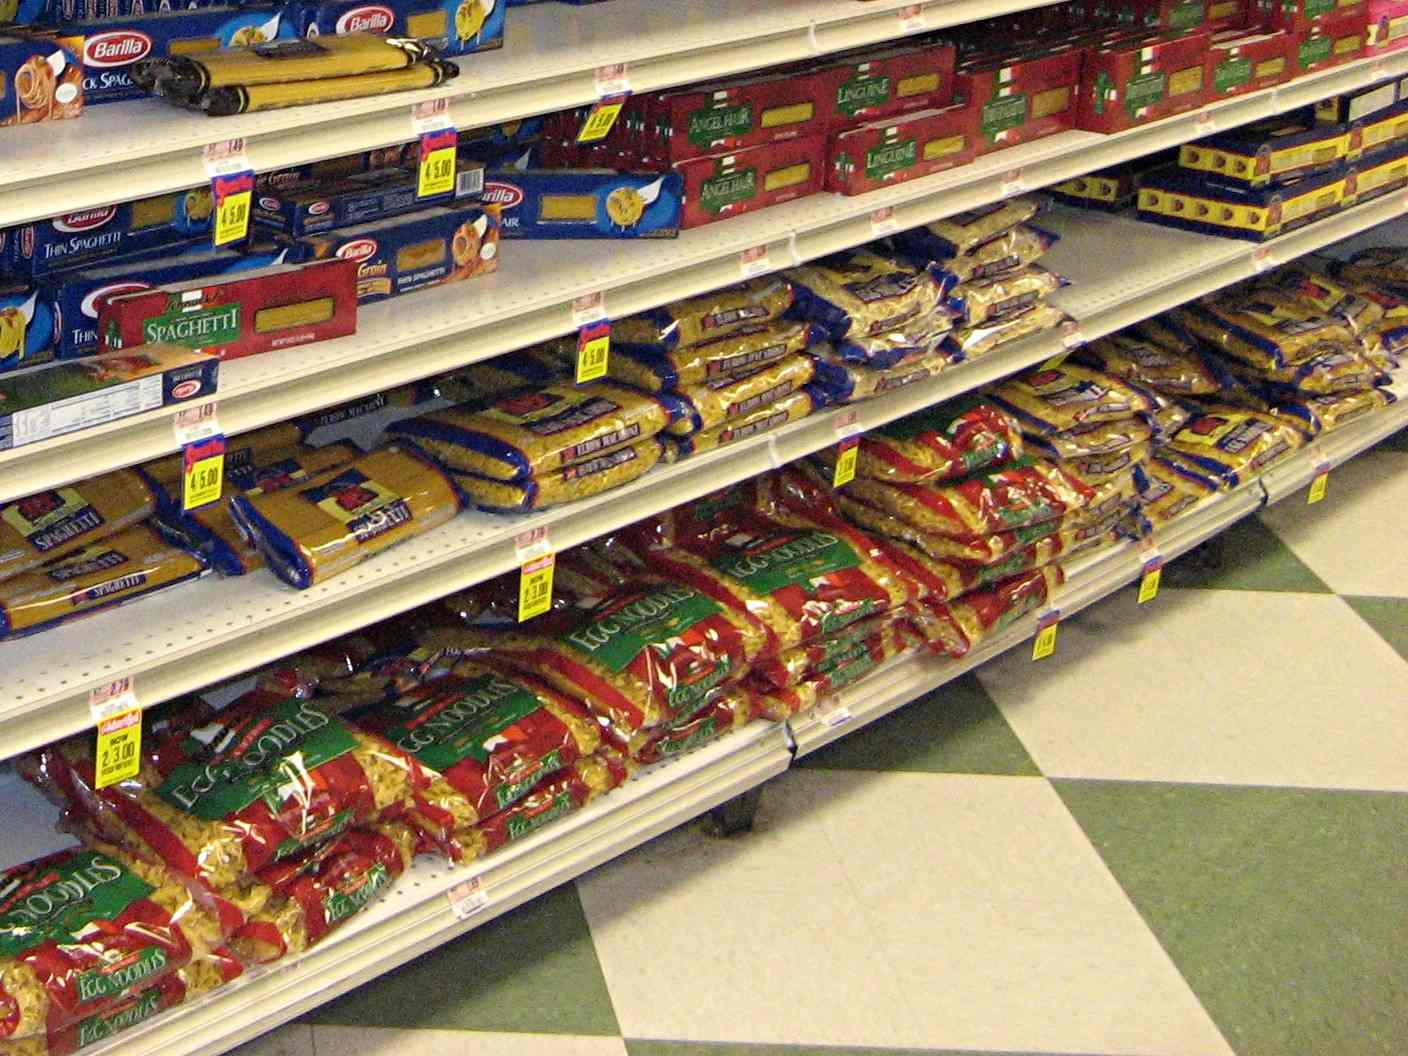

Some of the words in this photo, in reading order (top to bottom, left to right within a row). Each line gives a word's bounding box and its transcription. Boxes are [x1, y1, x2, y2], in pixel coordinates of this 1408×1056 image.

[94, 38, 144, 59] Barilla
[43, 240, 67, 260] THIN
[68, 231, 121, 254] SPAGHETTI
[147, 308, 238, 344] SPAGHETTI
[32, 512, 103, 550] SPAGHETTI
